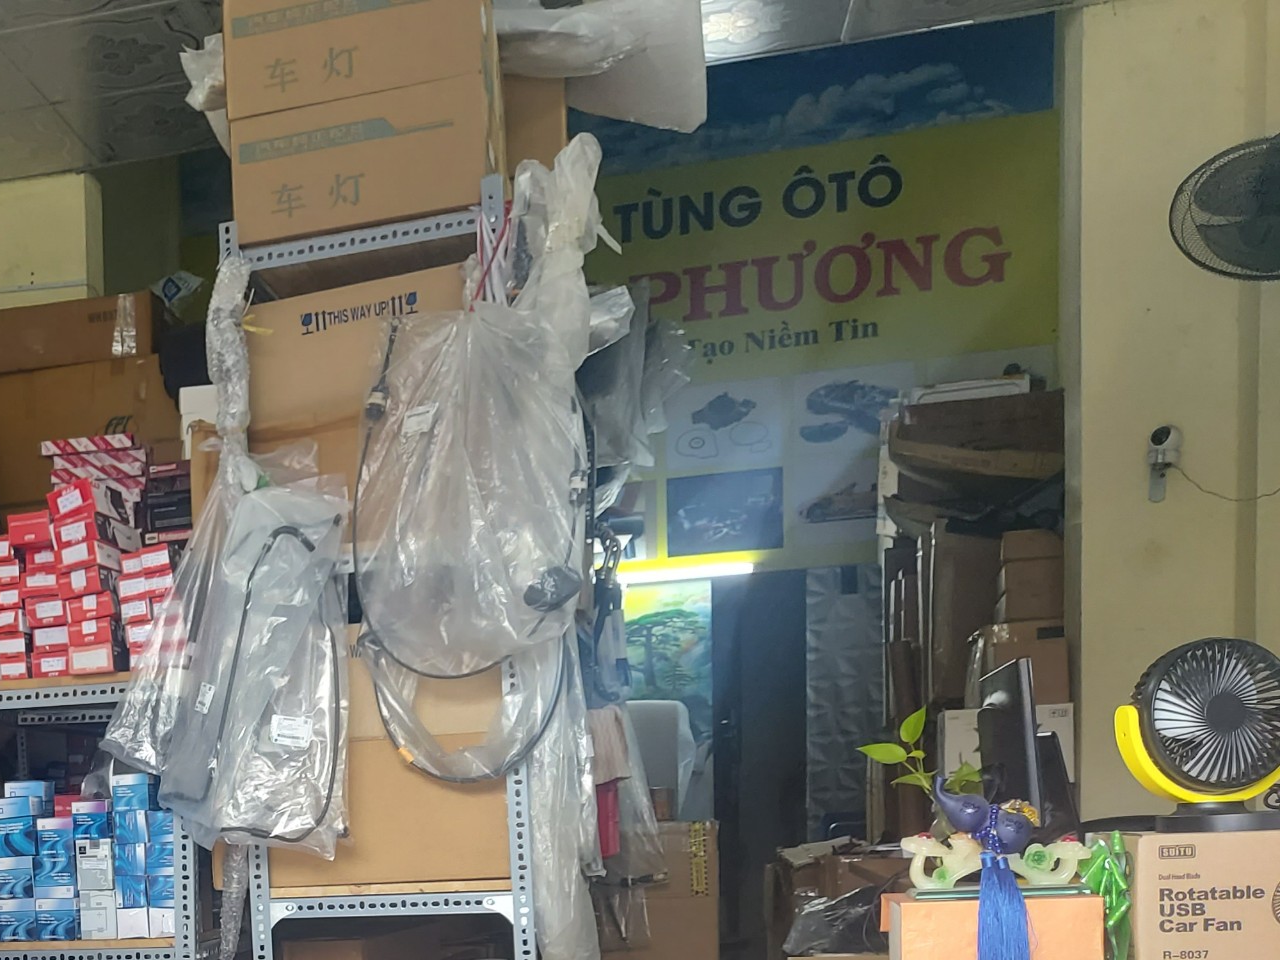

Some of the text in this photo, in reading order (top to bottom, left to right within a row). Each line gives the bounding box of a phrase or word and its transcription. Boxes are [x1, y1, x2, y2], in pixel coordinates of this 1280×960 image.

[612, 154, 903, 244] TÙNG ÔTÔ
[630, 226, 1013, 324] PHƯƠNG
[327, 300, 390, 325] THIS WAY UP!
[744, 319, 819, 353] Niềm
[828, 317, 880, 344] Tin
[1159, 885, 1266, 902] Rotatable
[1159, 902, 1207, 917] USB
[1158, 917, 1243, 933] Car Fan
[1162, 950, 1209, 960] R-8037
